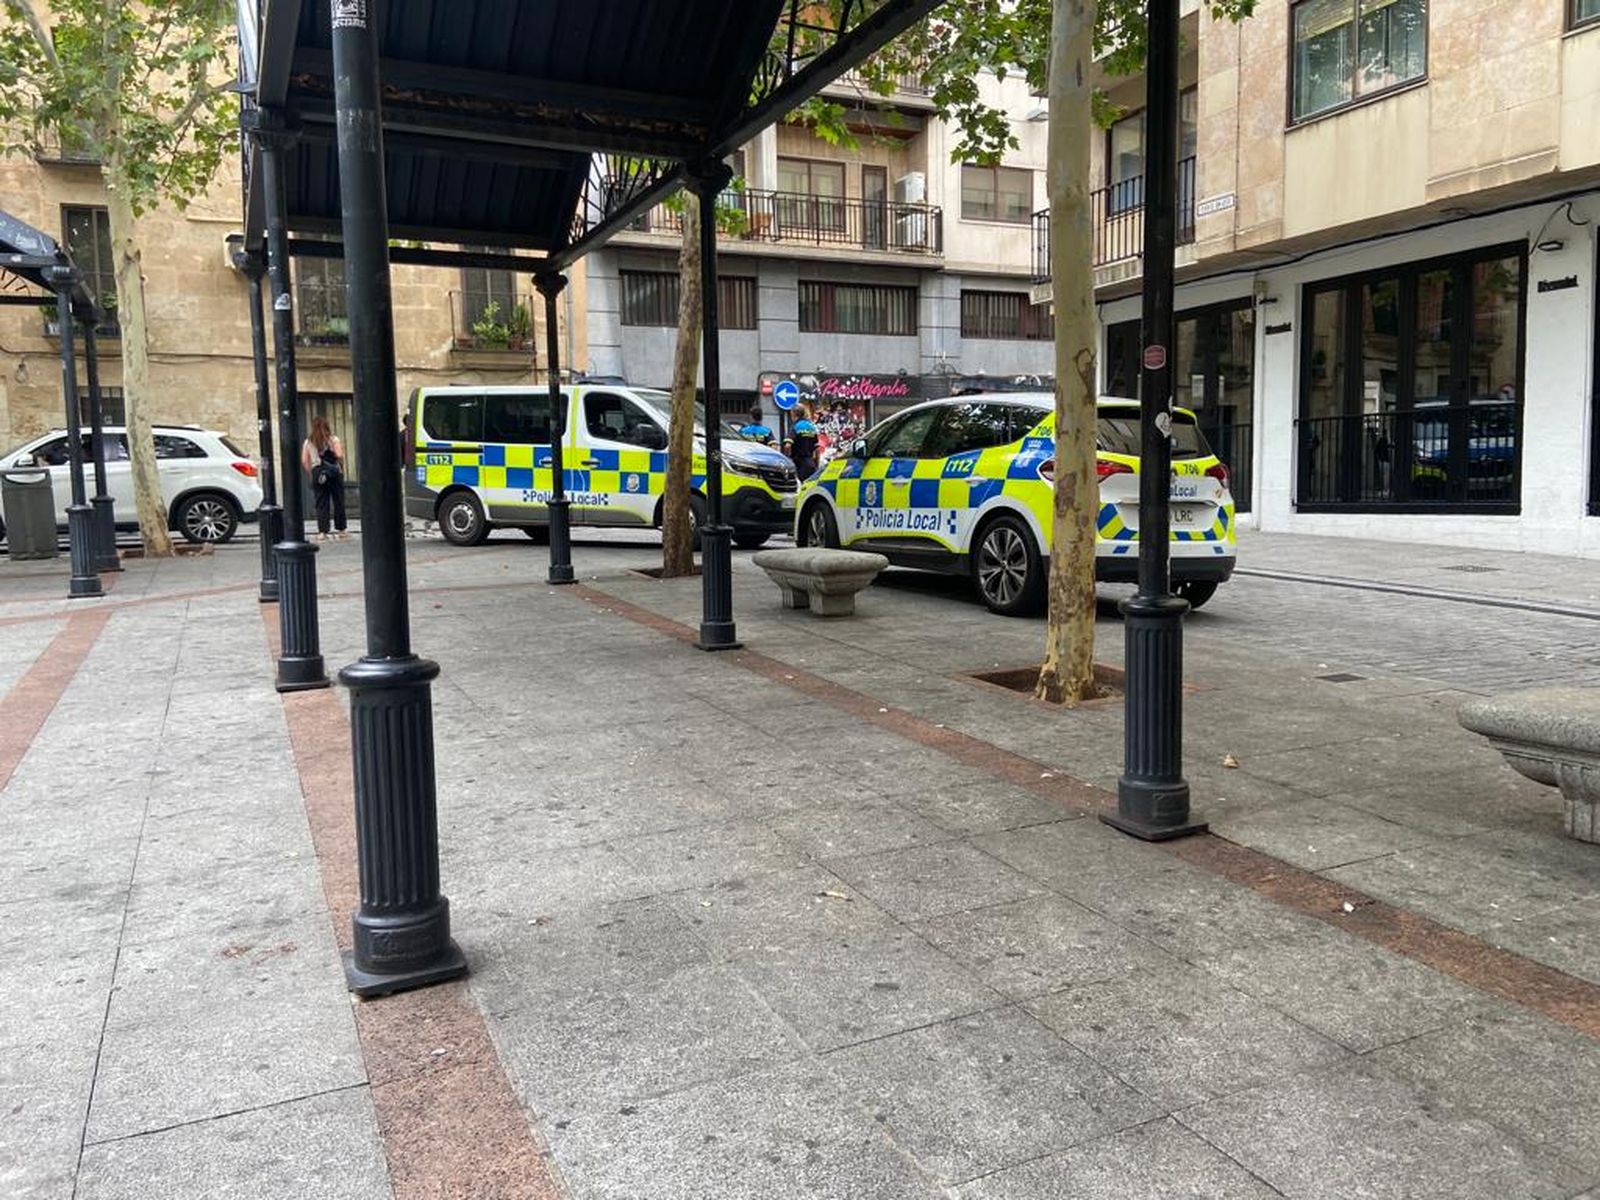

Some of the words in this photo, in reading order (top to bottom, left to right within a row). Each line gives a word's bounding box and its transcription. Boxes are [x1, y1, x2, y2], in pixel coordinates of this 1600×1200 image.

[434, 455, 450, 465] 112
[952, 459, 974, 473] 112
[571, 492, 601, 505] Local
[907, 509, 942, 531] Local
[1174, 510, 1193, 522] LRC
